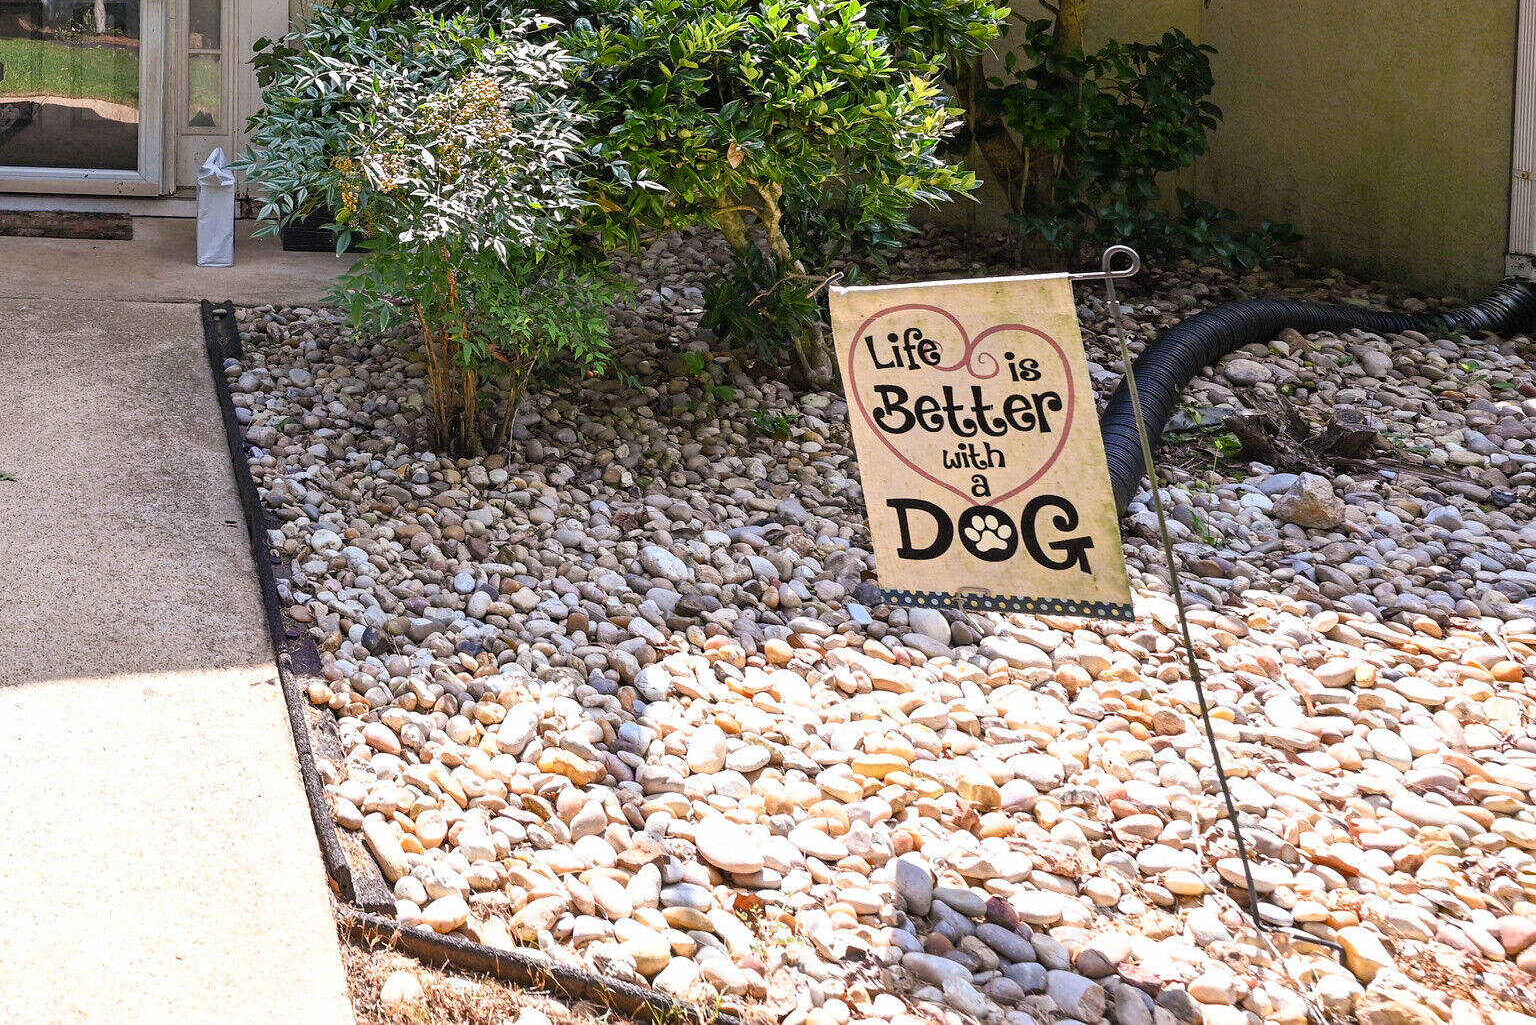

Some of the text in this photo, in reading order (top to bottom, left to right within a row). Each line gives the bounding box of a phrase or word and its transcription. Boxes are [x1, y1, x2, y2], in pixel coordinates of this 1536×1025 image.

[864, 327, 1041, 382] Life is
[872, 385, 1062, 437] Better
[942, 442, 1006, 470] with
[971, 474, 991, 497] a
[886, 494, 1094, 574] DOG
